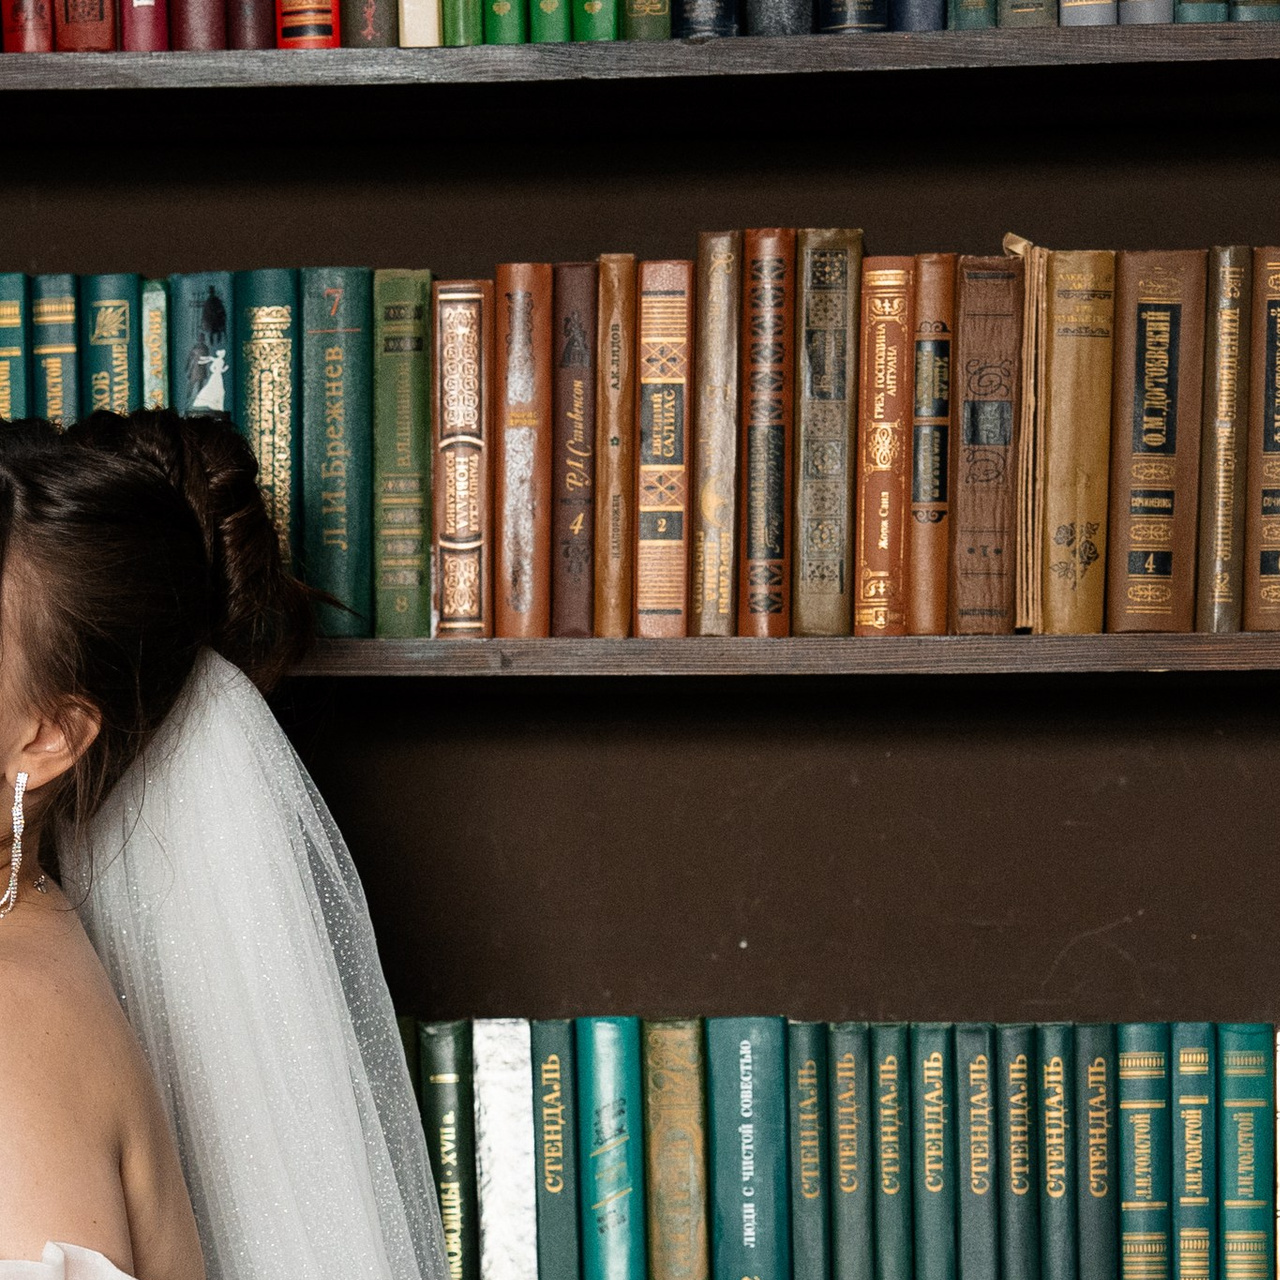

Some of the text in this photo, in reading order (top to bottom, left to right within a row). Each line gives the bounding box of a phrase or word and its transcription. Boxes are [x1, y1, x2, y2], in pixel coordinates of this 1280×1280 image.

[324, 288, 344, 317] 7
[91, 370, 110, 411] ХОВ
[874, 323, 888, 419] ГРЕХ ГОСПОДИНА
[886, 345, 898, 397] АНТУАНА
[1216, 307, 1240, 422] СНОВИДЕНИЙ
[650, 393, 663, 457] ЕВГЕНИЙ
[663, 389, 676, 459] САЛИАС
[445, 451, 455, 534] ВОЗРОЖДЕНИЯ
[455, 456, 468, 530] НОВЕЛЛА
[569, 512, 585, 535] 4
[657, 518, 667, 534] 2
[878, 519, 890, 550] Жорж
[1214, 426, 1236, 560] ЭНЦИКЛОПЕДИЯ
[1144, 552, 1156, 573] 4
[542, 1053, 564, 1194] СТЕНДАЛЬ
[738, 1039, 753, 1119] СОВЕСТЬЮ
[837, 1052, 860, 1194] СТЕНДАЛЬ
[924, 1051, 947, 1193] СТЕНДАЛЬ
[798, 1058, 820, 1200] СТЕНДАЛЬ
[880, 1054, 901, 1195] СТЕНДАЛЬ
[970, 1053, 992, 1196] СТЕНДАЛЬ
[1010, 1052, 1032, 1196] СТЕНДАЛЬ
[1043, 1055, 1069, 1198] СТЕНДАЛЬ
[1088, 1056, 1112, 1198] СТЕНДАЛЬ
